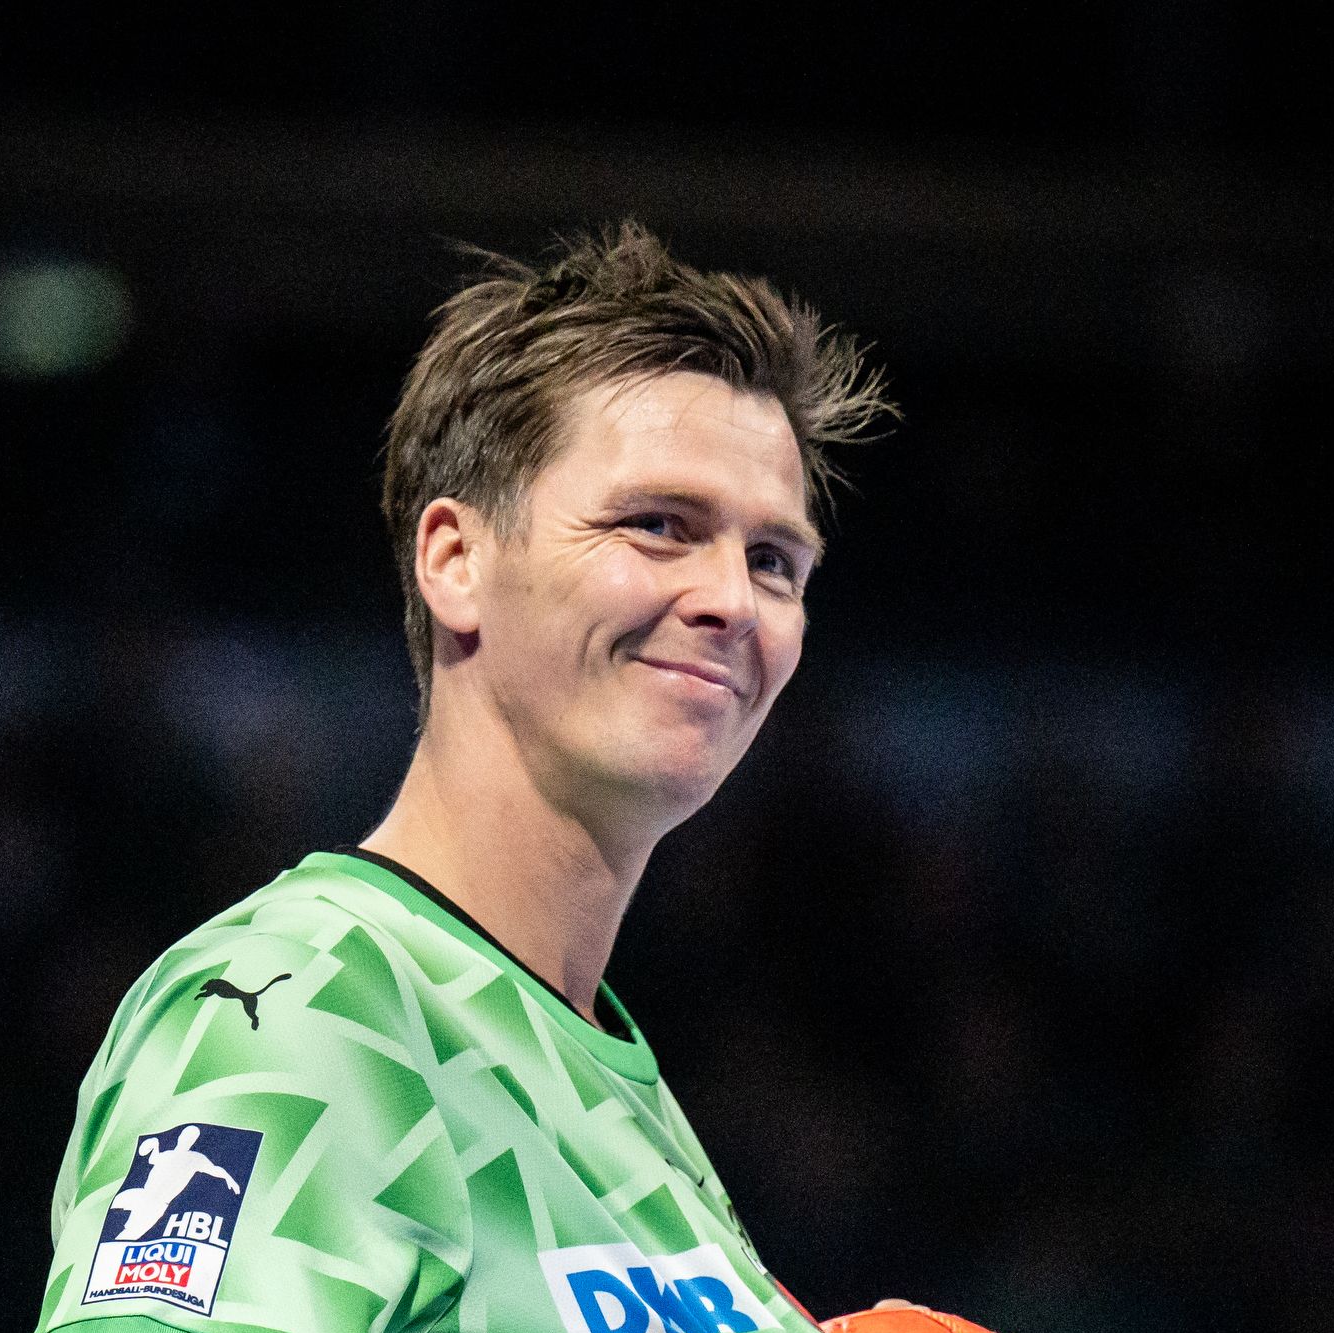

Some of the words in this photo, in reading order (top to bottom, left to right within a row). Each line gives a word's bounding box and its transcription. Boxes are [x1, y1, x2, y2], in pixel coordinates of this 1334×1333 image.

[162, 1211, 229, 1249] HBL
[124, 1243, 193, 1264] LIQUI
[118, 1262, 190, 1284] MOLY
[89, 1285, 206, 1308] HANDBALL-BUNDESLIGA
